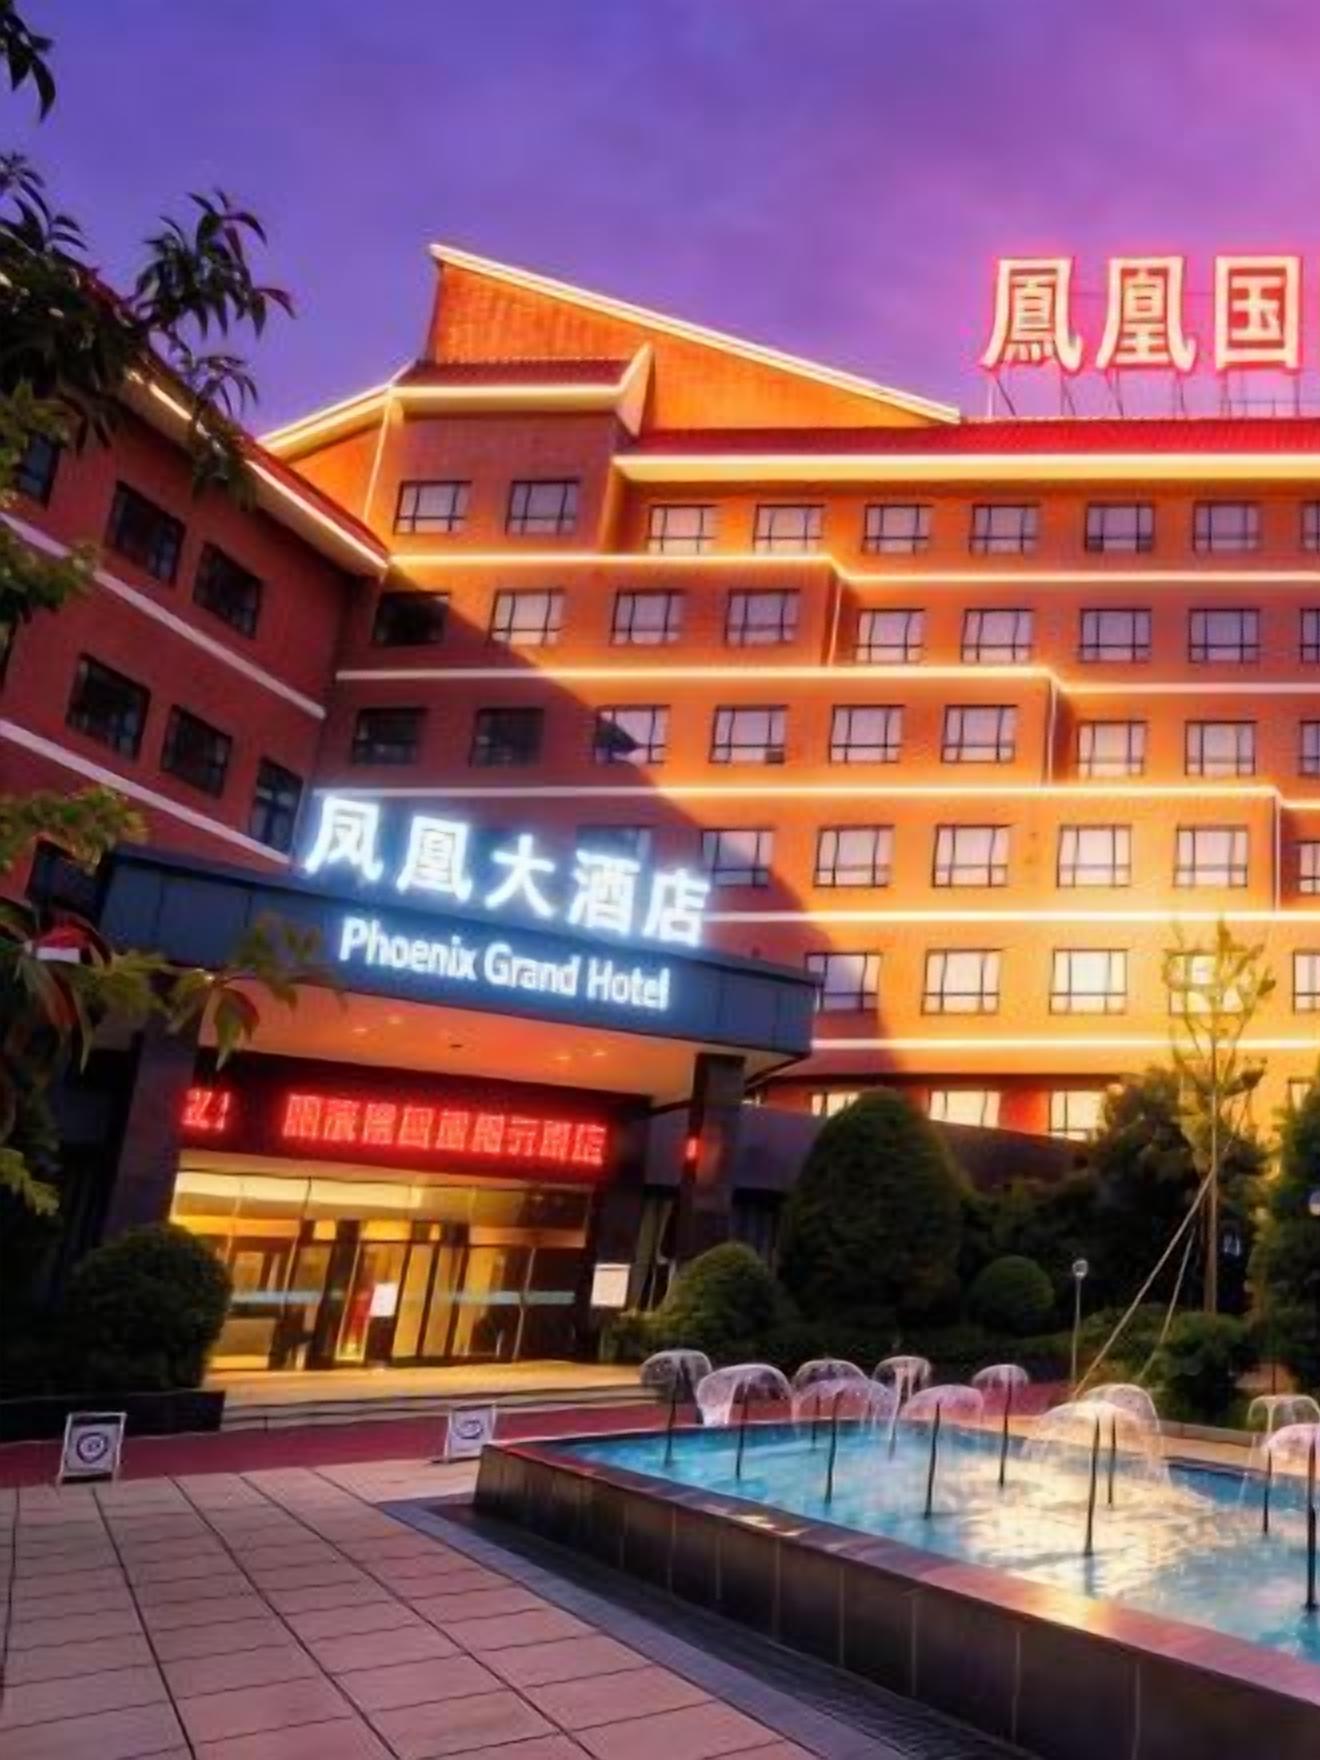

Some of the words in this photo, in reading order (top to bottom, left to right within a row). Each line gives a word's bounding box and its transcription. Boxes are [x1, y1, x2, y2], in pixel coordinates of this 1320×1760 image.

[304, 796, 711, 947] 凤凰大酒店
[338, 915, 478, 982] Phoenix
[483, 942, 583, 997] Grand
[586, 955, 671, 1011] Hotel
